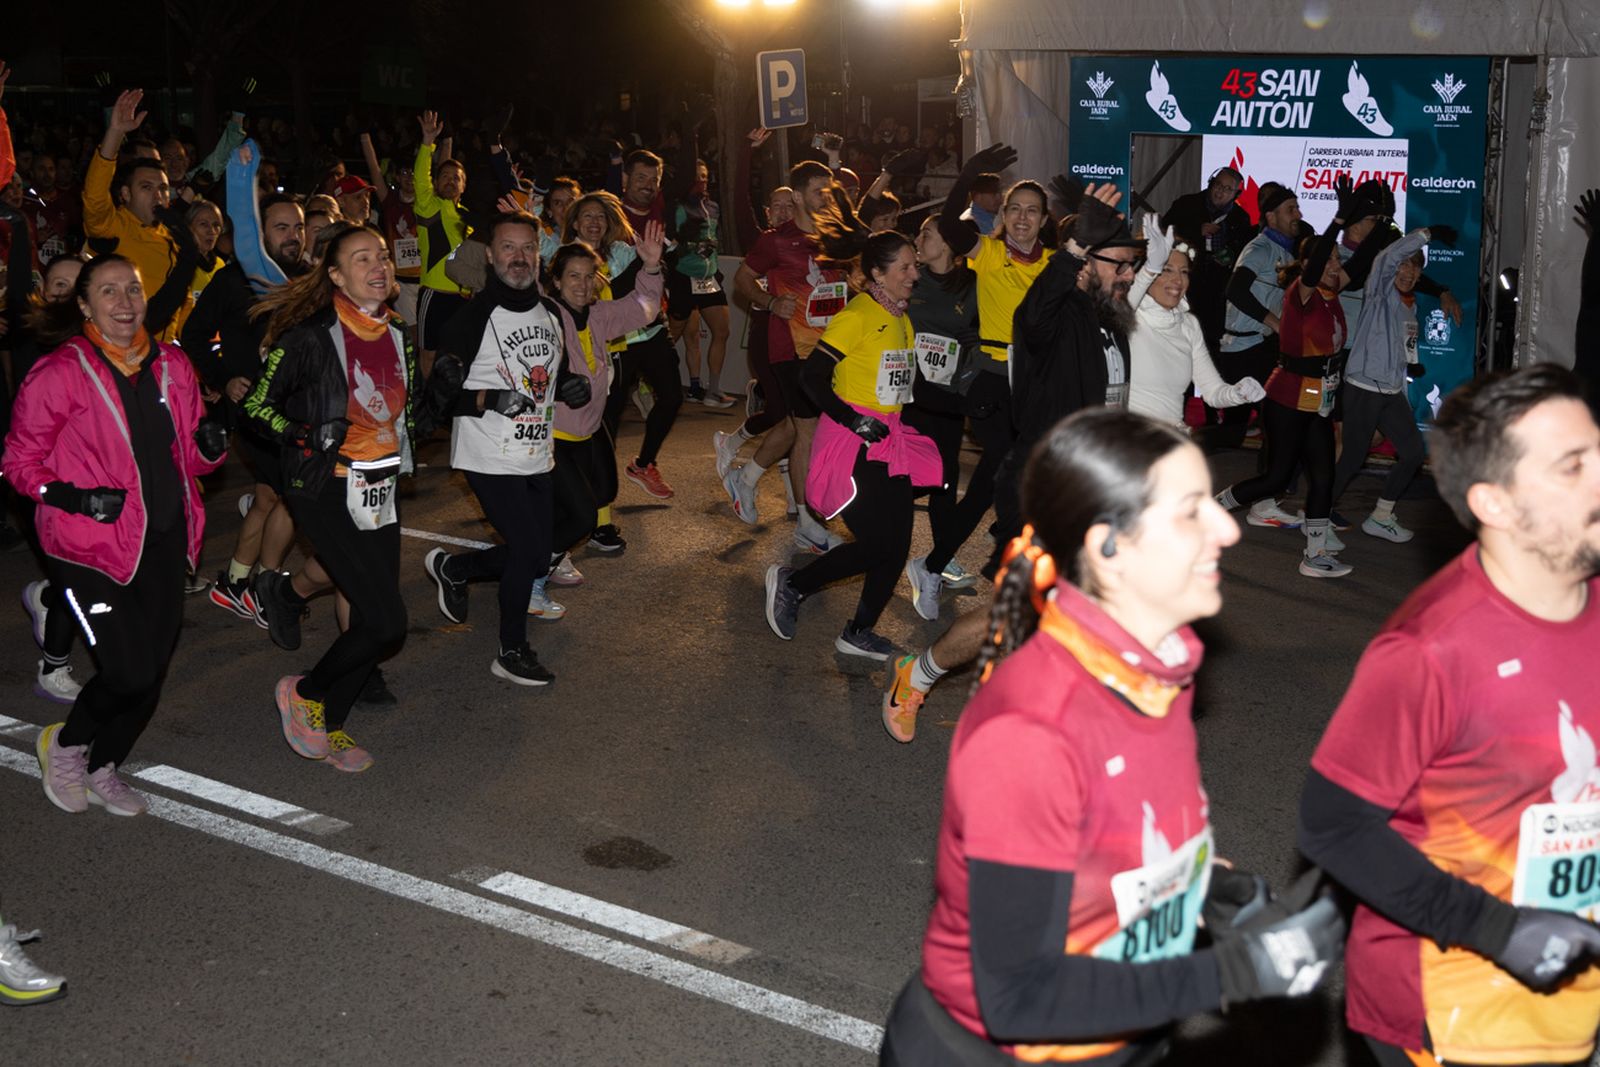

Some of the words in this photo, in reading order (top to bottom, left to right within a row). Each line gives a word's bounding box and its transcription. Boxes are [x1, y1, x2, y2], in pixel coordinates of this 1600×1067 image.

[376, 63, 414, 89] WC
[1220, 68, 1257, 98] 43
[1257, 68, 1321, 97] SAN
[768, 60, 797, 119] P
[1158, 100, 1177, 120] 43
[1211, 93, 1314, 129] ANTÓN
[1357, 102, 1377, 124] 43
[1422, 105, 1443, 113] CAJA
[1444, 105, 1473, 114] RURAL
[1308, 147, 1342, 156] CARRERA
[1343, 148, 1374, 157] URBANA
[1071, 163, 1124, 175] calderón
[1306, 158, 1339, 168] NOCHE
[1341, 159, 1354, 168] DE
[1302, 168, 1351, 190] SAN
[1411, 176, 1476, 189] calderón
[1308, 192, 1319, 200] DE
[503, 326, 556, 351] HELLFIRE
[522, 343, 550, 358] CLUB
[924, 351, 947, 368] 404
[367, 395, 384, 413] 43
[514, 423, 548, 440] 3425
[1540, 837, 1573, 856] SAN
[1548, 853, 1600, 898] 80
